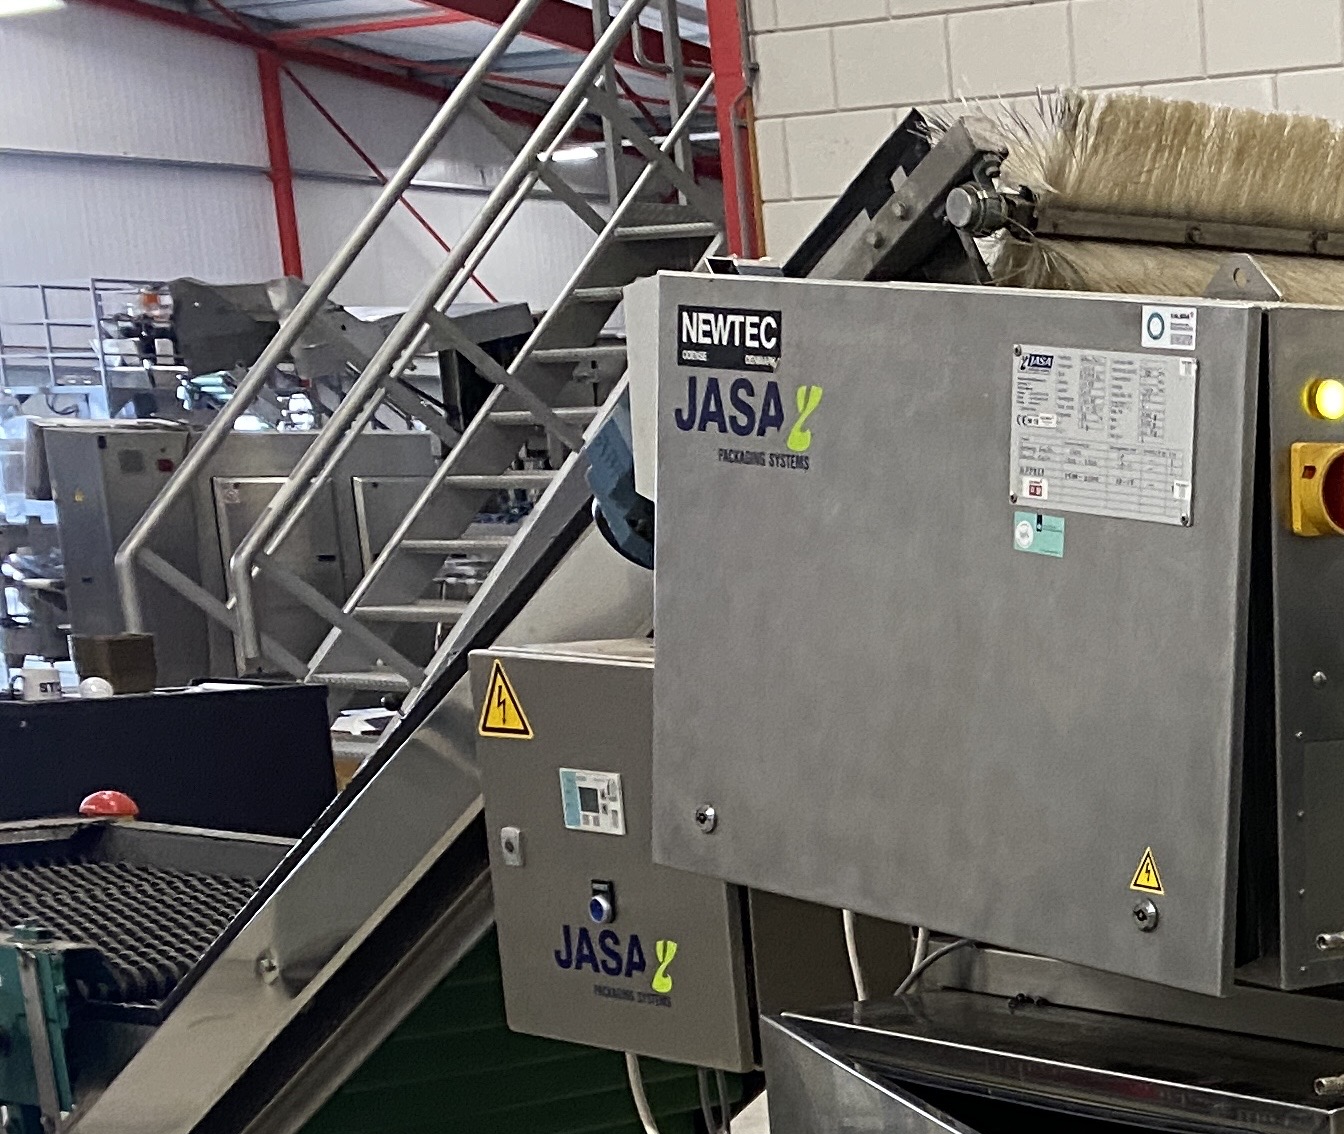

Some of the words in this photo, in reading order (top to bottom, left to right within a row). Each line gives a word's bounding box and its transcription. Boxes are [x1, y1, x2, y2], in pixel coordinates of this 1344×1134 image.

[682, 311, 778, 349] NEWTEC
[674, 376, 785, 437] JASA
[769, 453, 810, 471] SYSTEMS
[554, 925, 646, 978] JASA
